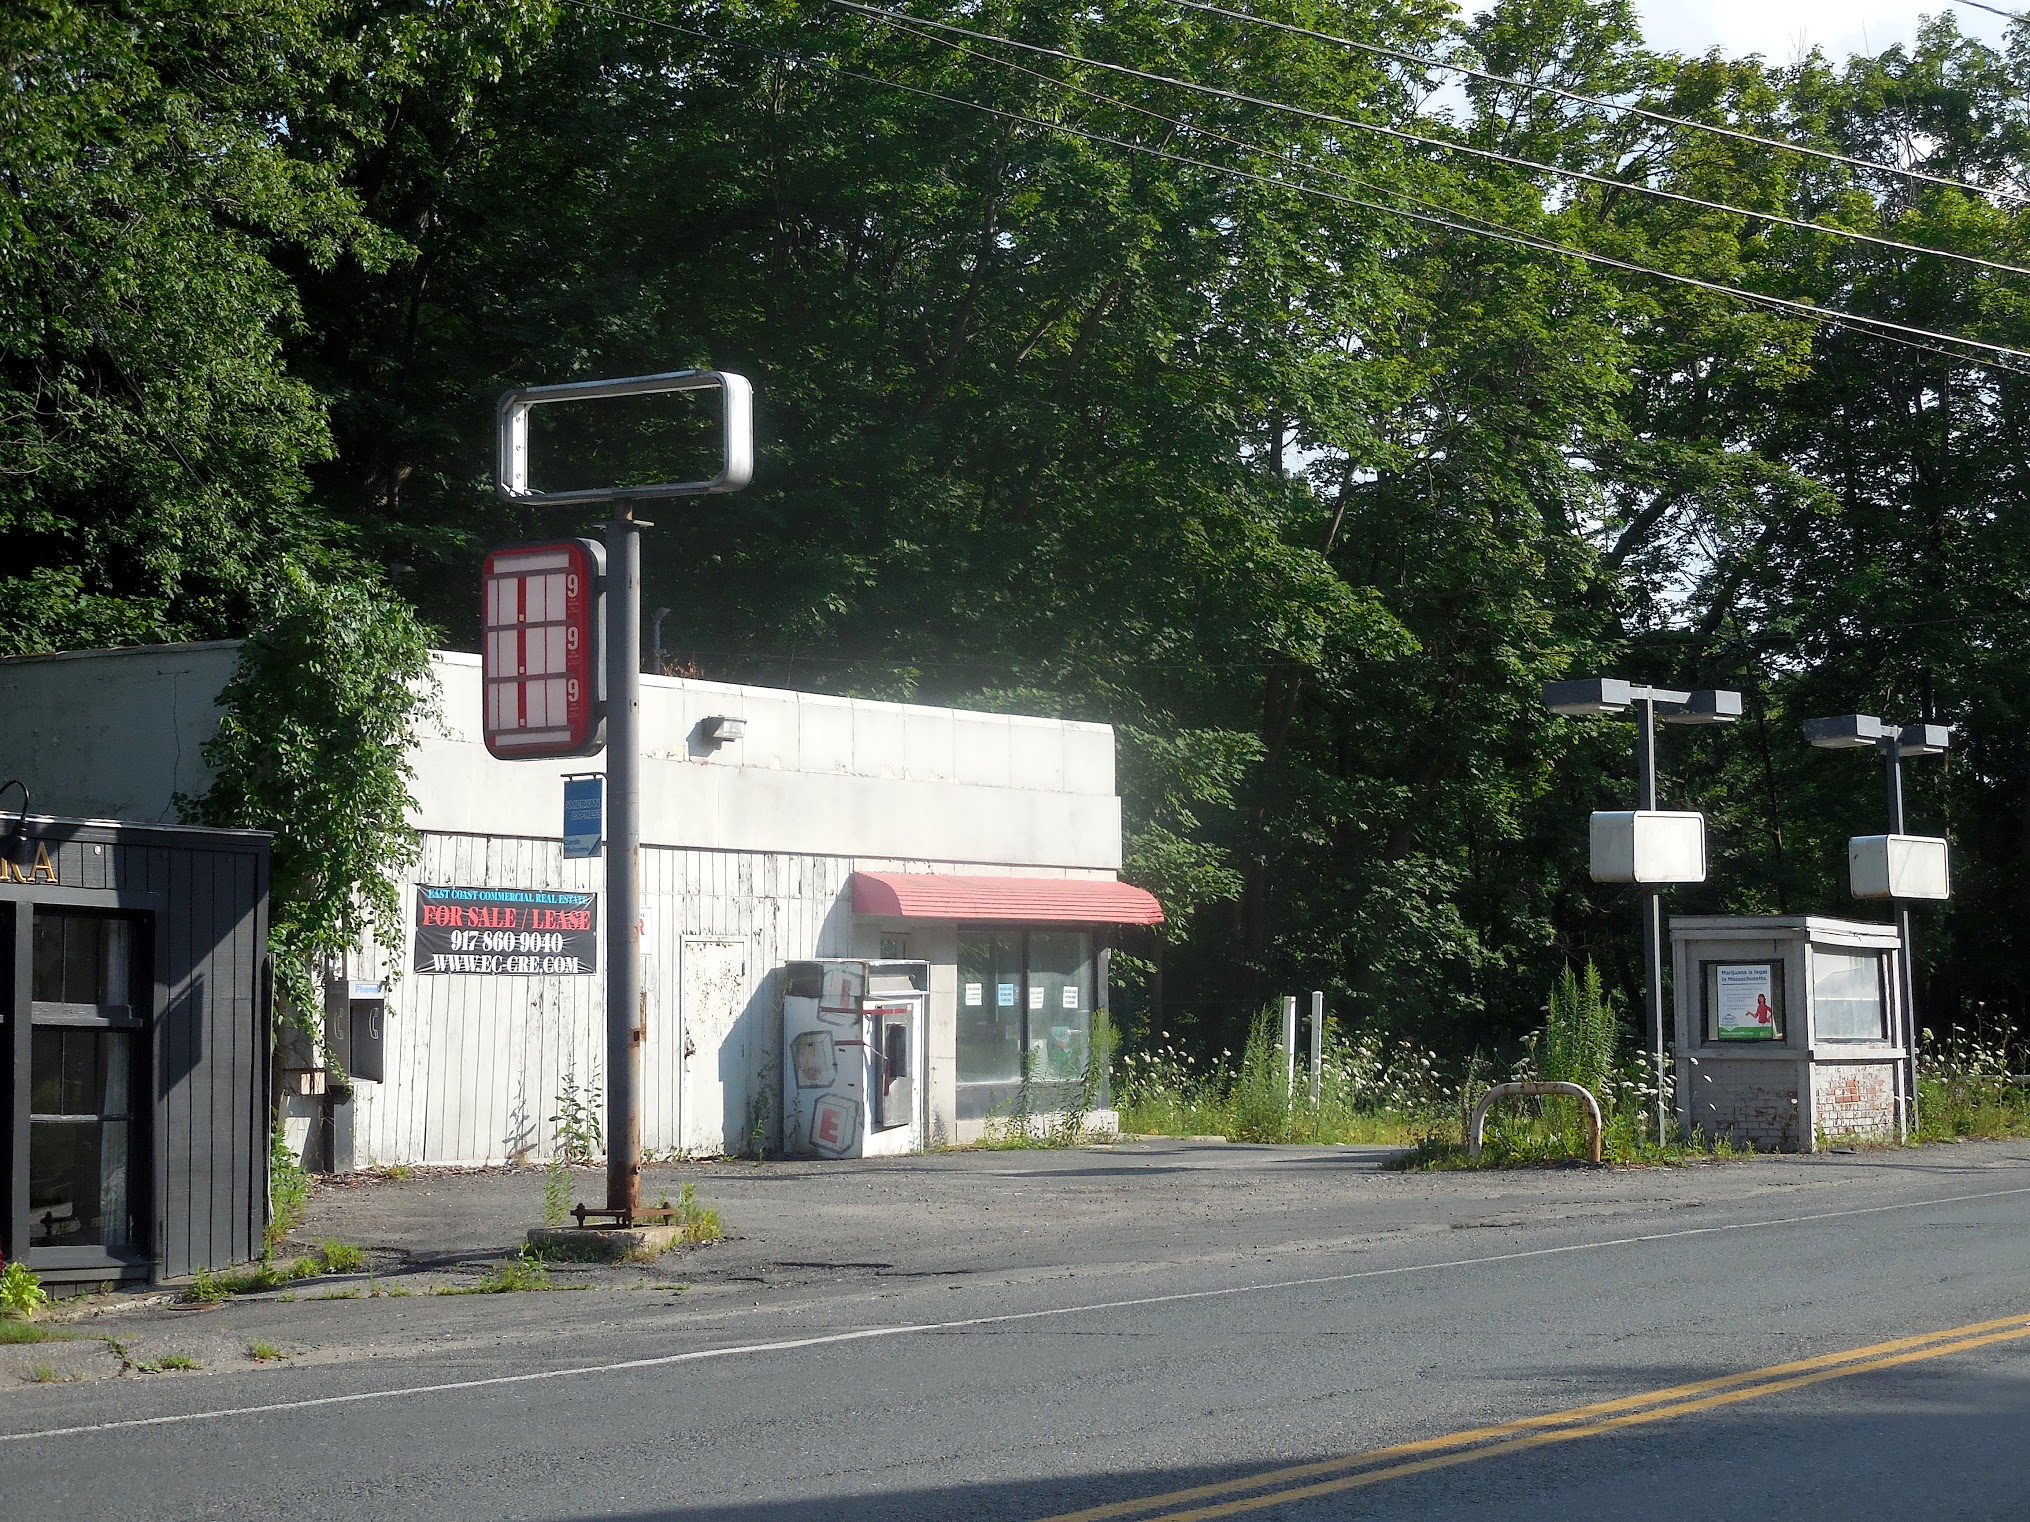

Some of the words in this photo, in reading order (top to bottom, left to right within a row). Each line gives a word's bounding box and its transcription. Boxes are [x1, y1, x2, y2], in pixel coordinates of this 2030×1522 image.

[567, 574, 579, 598] 9
[567, 626, 579, 650] 9
[567, 678, 579, 702] 9
[565, 798, 600, 810] AMERICAN
[571, 809, 601, 820] EXPRESS
[427, 888, 451, 900] EAST
[451, 889, 479, 901] COAST
[478, 890, 535, 904] COMMERCIAL
[535, 892, 558, 905] REAL
[558, 893, 590, 905] ESTATE
[422, 905, 463, 927] FOR
[467, 906, 517, 929] SALE
[520, 907, 529, 930] /
[531, 909, 592, 931] LEASE
[450, 930, 480, 952] 917
[482, 931, 516, 953] 860
[519, 932, 565, 953] 9040
[432, 953, 580, 974] WWW.EC-CRE.COM
